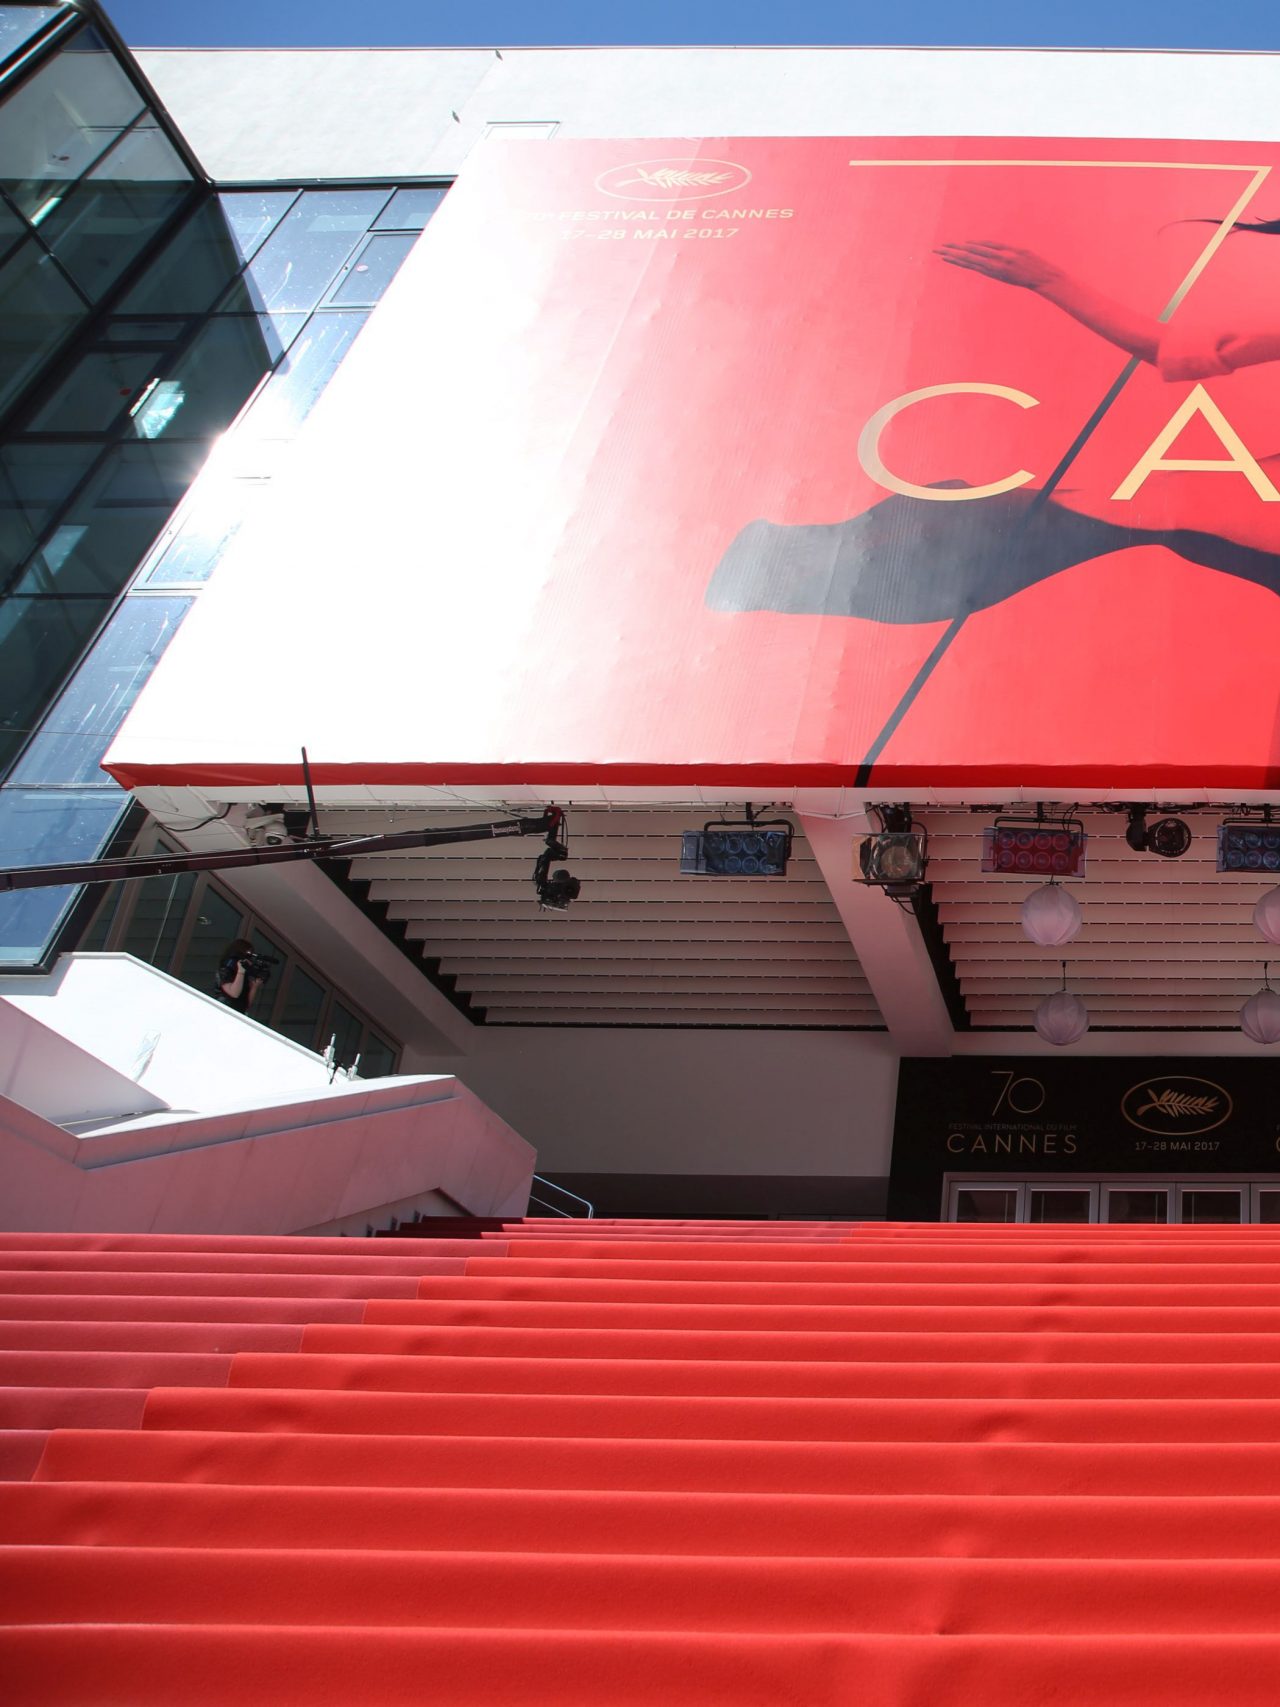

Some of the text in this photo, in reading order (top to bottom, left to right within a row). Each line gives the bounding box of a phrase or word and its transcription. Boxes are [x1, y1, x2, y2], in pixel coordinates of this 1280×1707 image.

[558, 209, 660, 222] FESTIVAL
[666, 208, 697, 221] DE
[702, 208, 794, 220] CANNES
[633, 228, 679, 240] MAI
[683, 227, 739, 240] 2017
[991, 1070, 1046, 1117] 70
[946, 1132, 1078, 1154] CANNES
[1135, 1140, 1221, 1151] 17-28 MAI 2017
